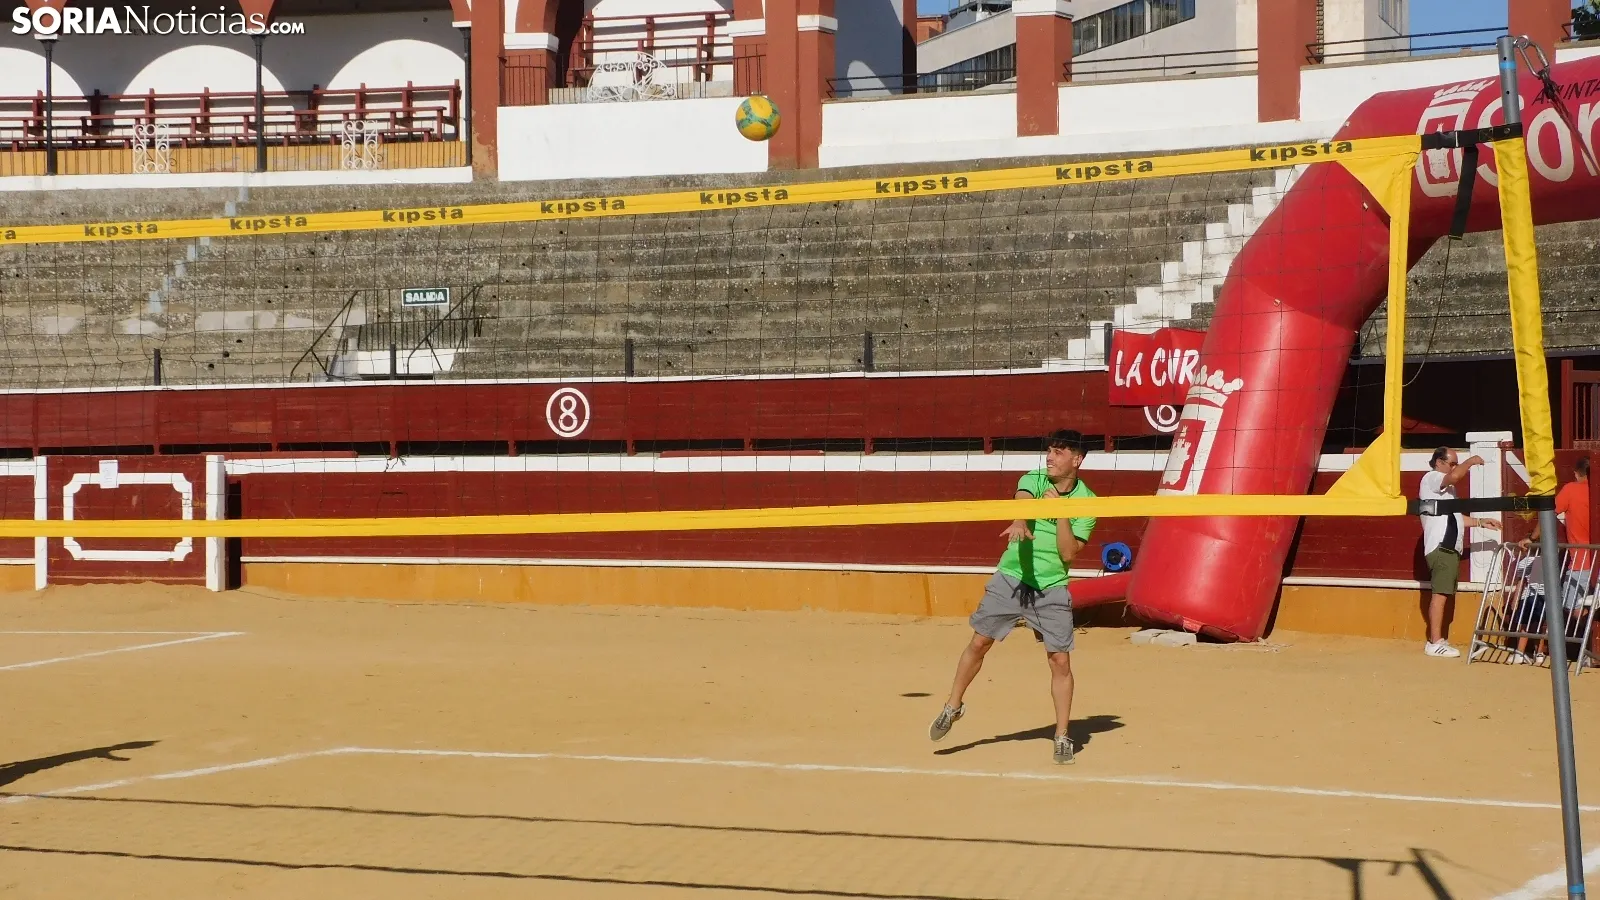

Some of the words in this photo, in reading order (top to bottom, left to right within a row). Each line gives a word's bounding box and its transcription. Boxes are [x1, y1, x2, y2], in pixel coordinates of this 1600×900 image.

[84, 221, 158, 237] kipsta
[230, 215, 308, 231] kipsta
[382, 207, 463, 224] kipsta
[540, 198, 625, 215] kipsta
[700, 188, 788, 206] kipsta
[875, 176, 969, 194] kipsta
[1056, 160, 1153, 181] kipsta
[1250, 141, 1352, 162] kipsta
[405, 291, 445, 303] SALIDA
[1114, 349, 1143, 388] LA
[558, 395, 578, 432] 8
